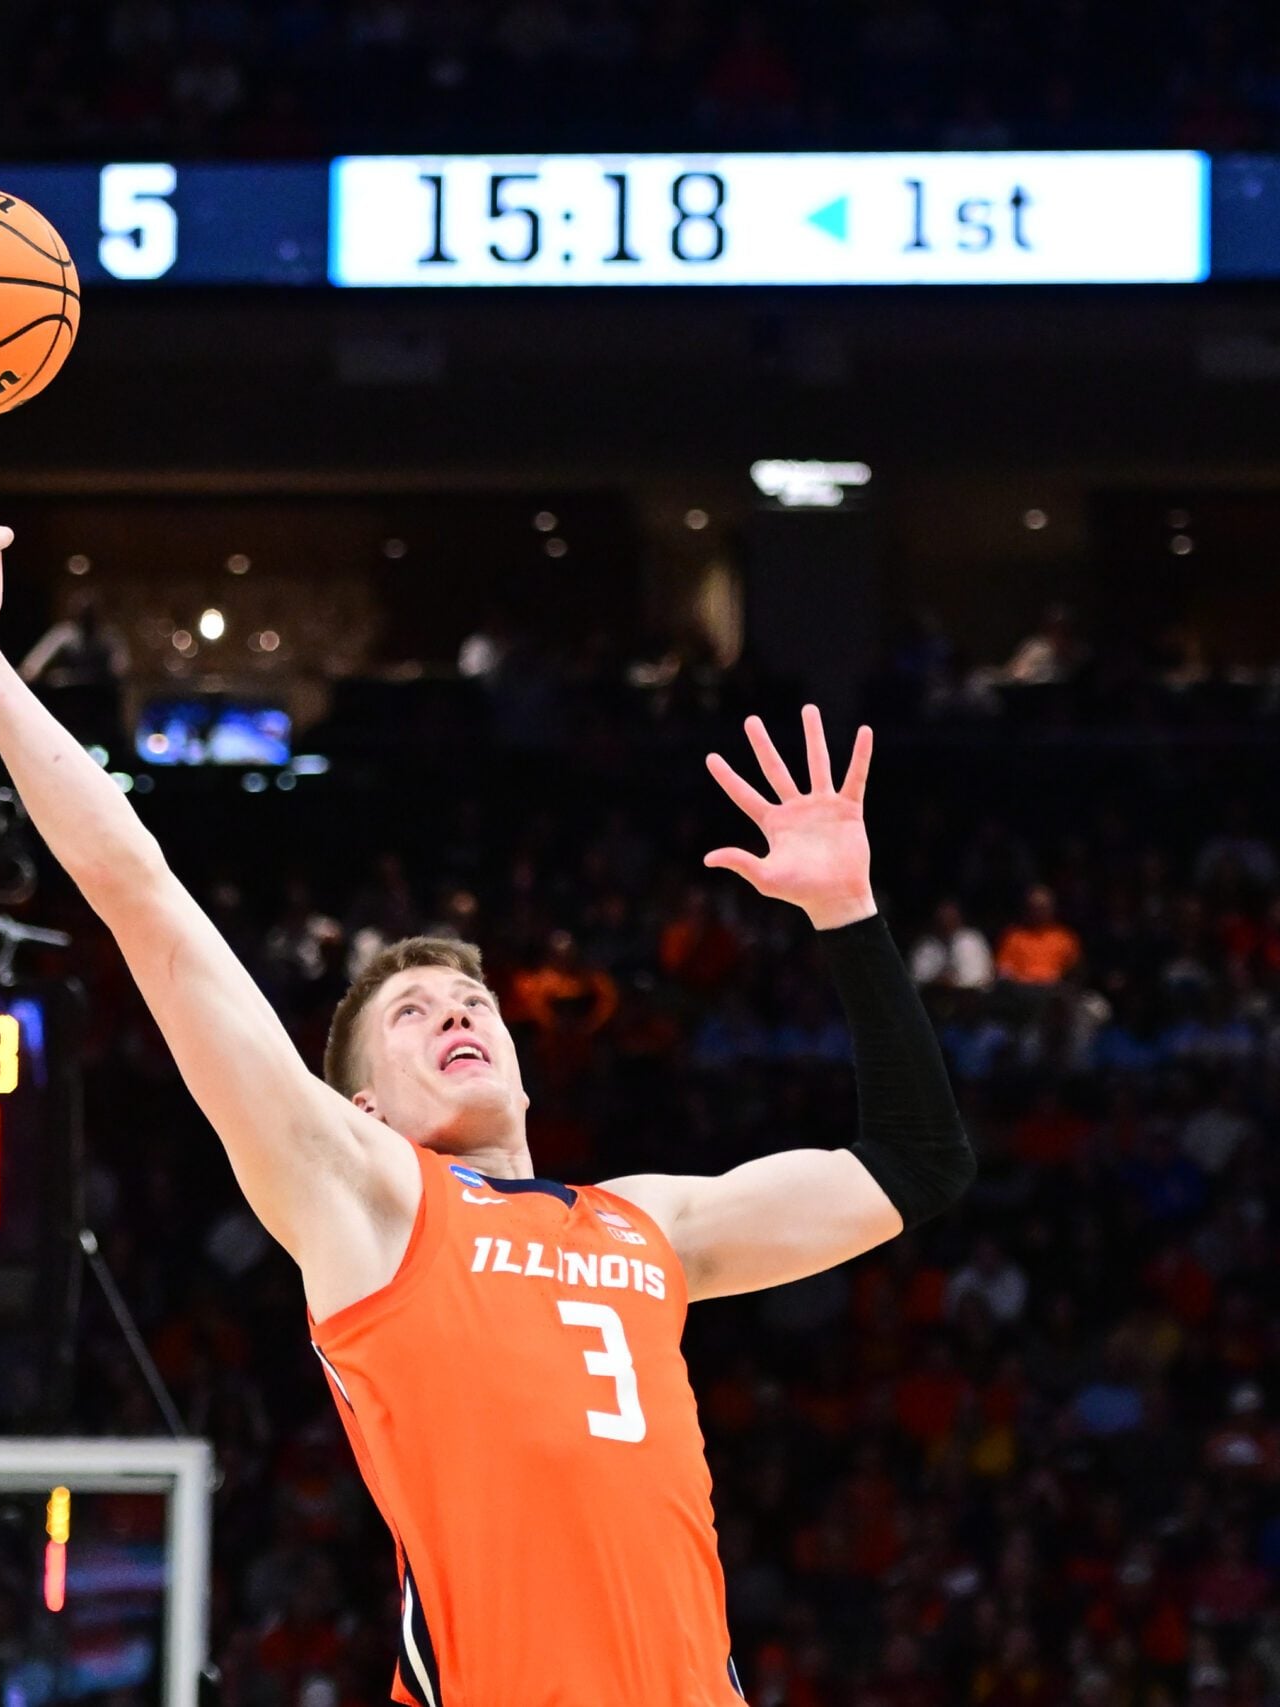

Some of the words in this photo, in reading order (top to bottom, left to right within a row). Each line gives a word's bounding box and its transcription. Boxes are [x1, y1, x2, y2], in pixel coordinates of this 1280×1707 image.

[99, 163, 177, 280] 5
[418, 172, 727, 263] 15:18
[903, 179, 1032, 252] 1st
[556, 1300, 647, 1443] 3
